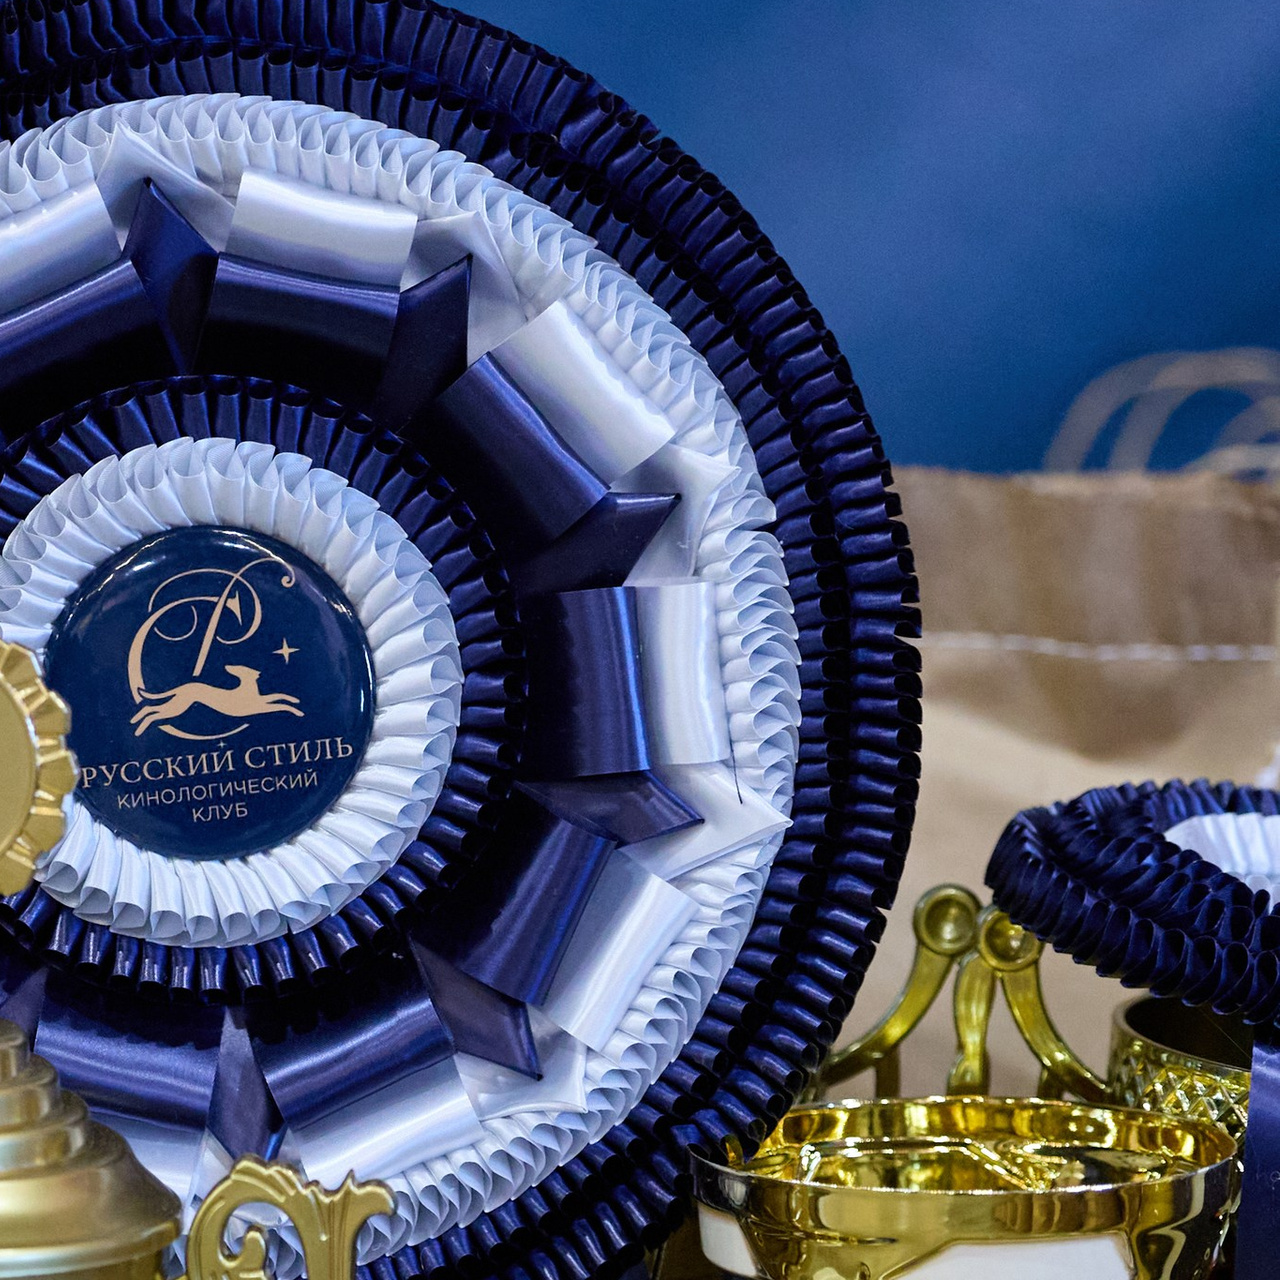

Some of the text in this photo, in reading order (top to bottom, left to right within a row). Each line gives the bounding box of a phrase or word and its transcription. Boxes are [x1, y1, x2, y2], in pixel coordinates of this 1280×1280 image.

[81, 736, 354, 789] РУССКИЙ СТИЛЬ
[116, 767, 319, 810] КИНОЛОГИЧЕСКИЙ
[191, 801, 249, 824] КЛУБ
